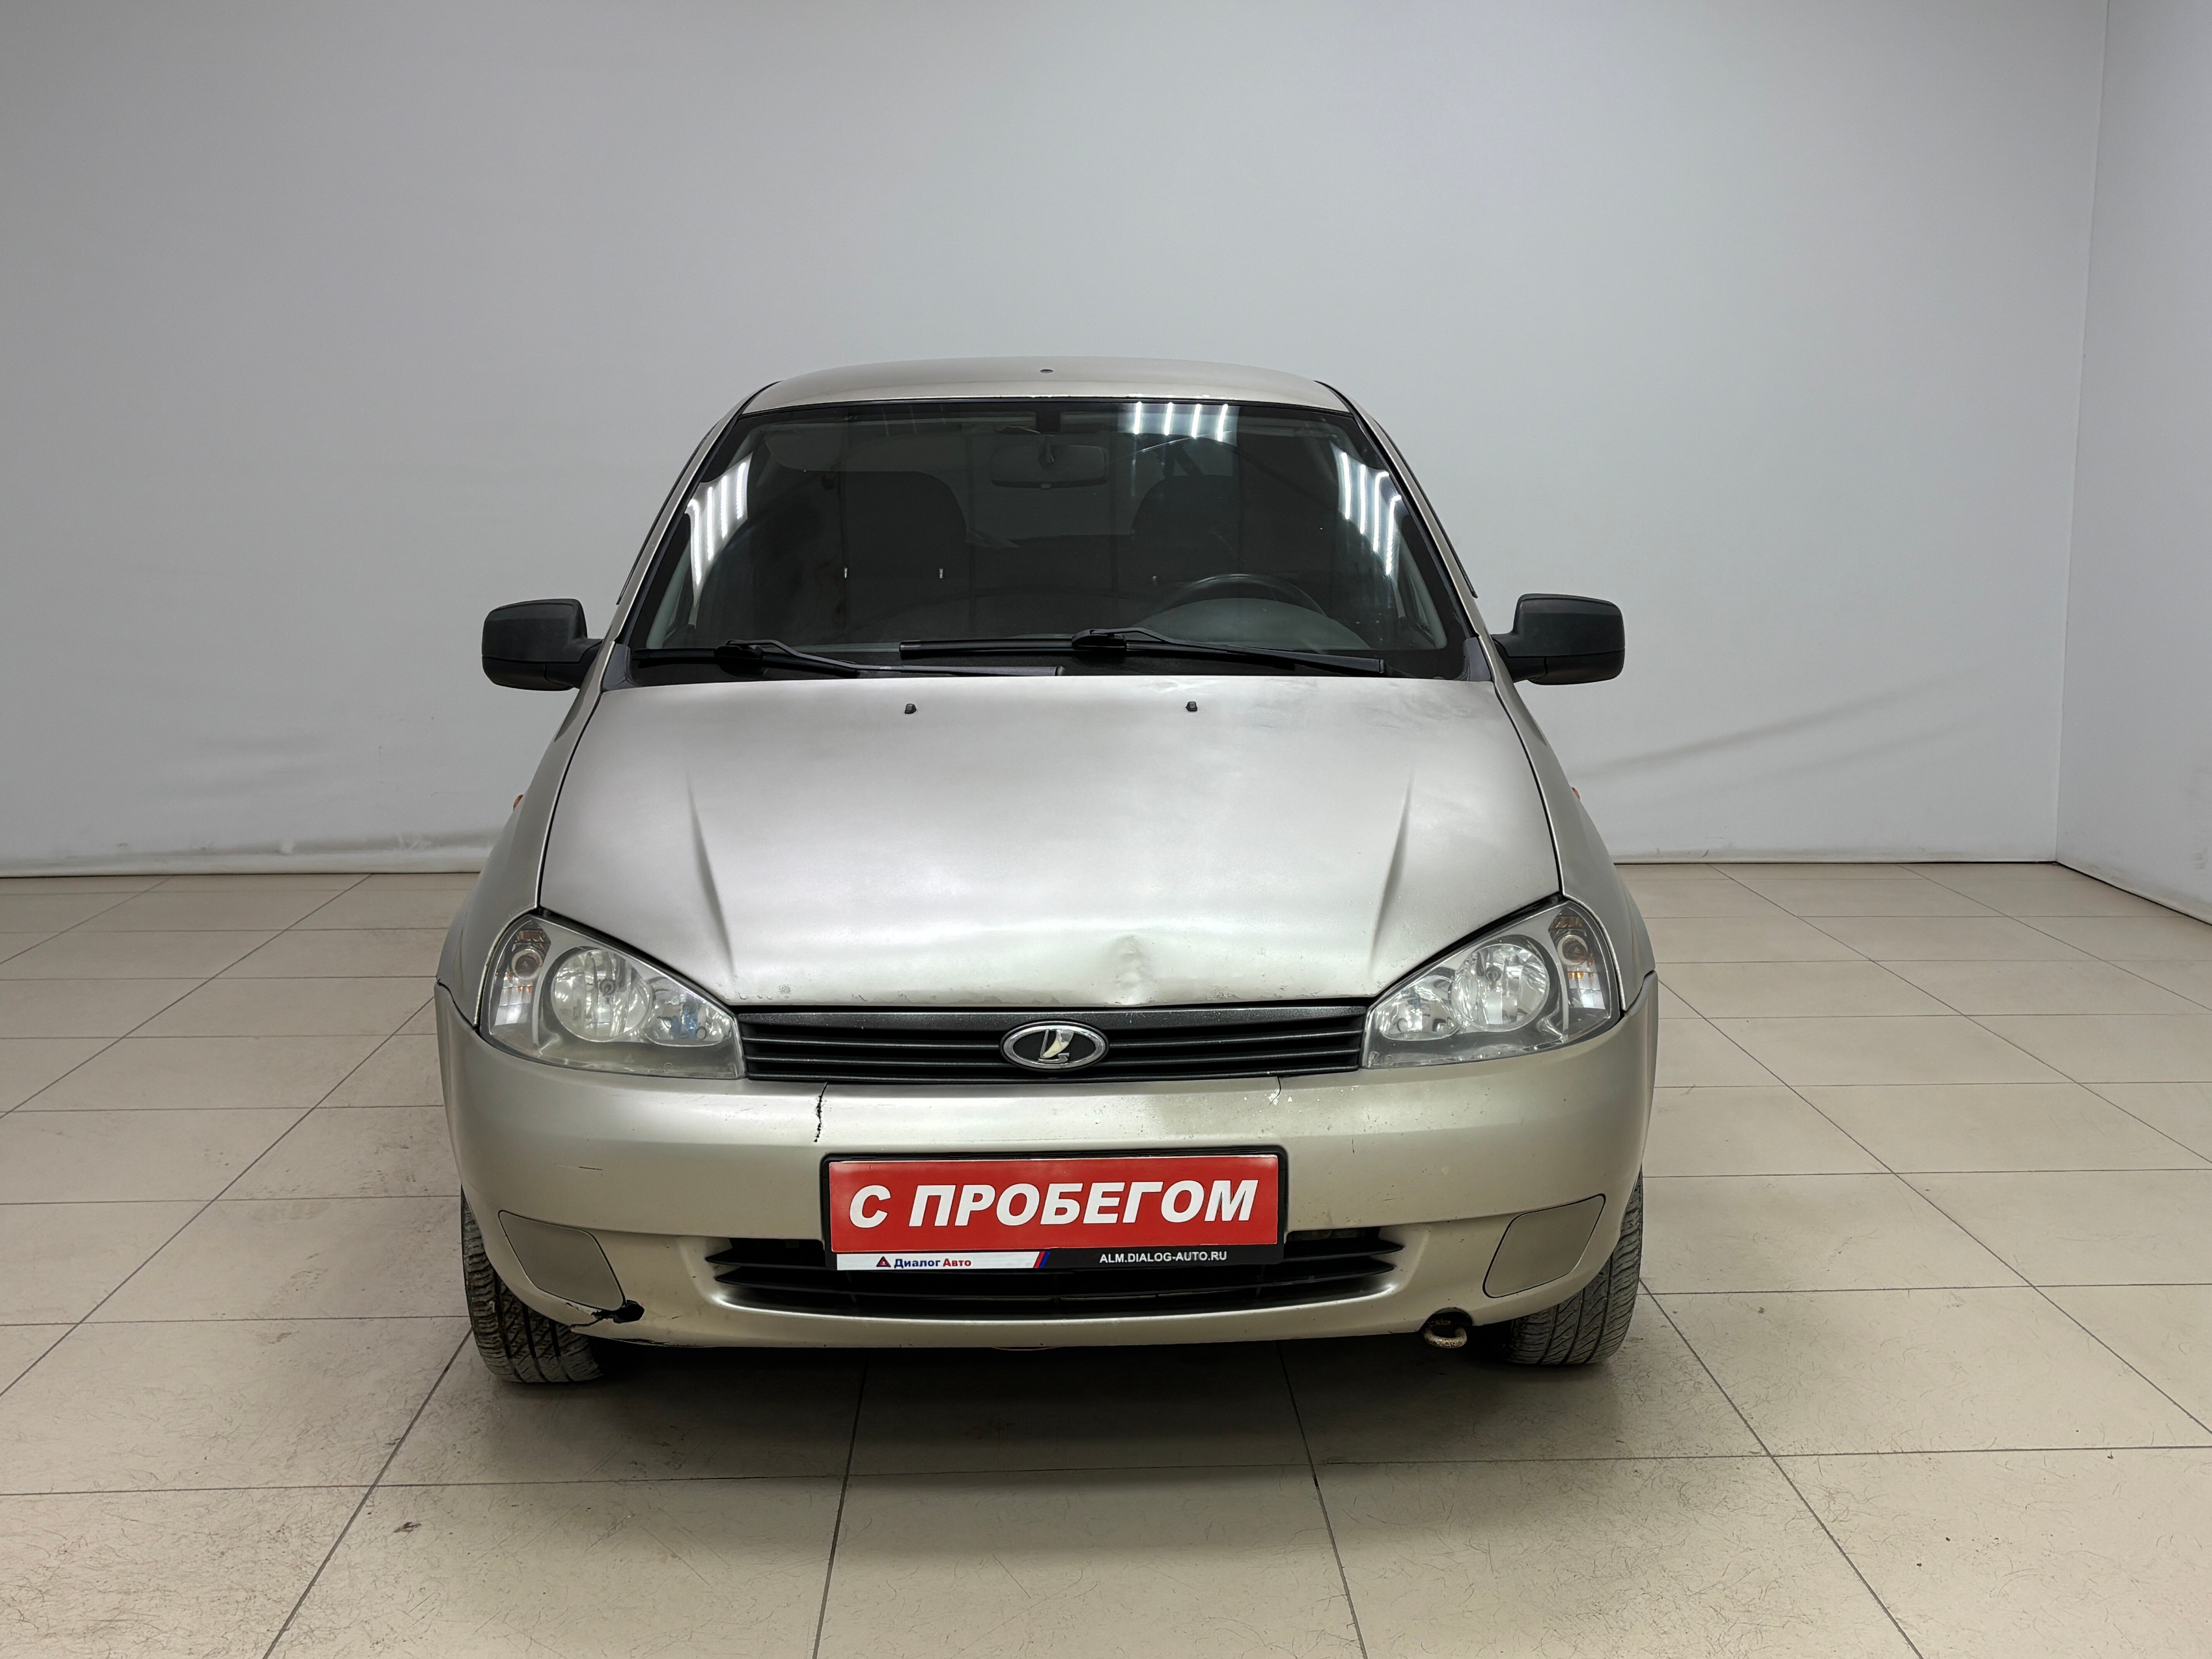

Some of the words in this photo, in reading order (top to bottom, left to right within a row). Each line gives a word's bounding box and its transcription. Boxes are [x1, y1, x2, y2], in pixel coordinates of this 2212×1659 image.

[849, 1185, 891, 1228] С
[908, 1180, 1259, 1227] ПРОБЕГОМ
[894, 1259, 941, 1268] Диалог
[943, 1258, 972, 1267] Авто
[1099, 1251, 1227, 1263] ALM.DIALOG-AUTO.RU
